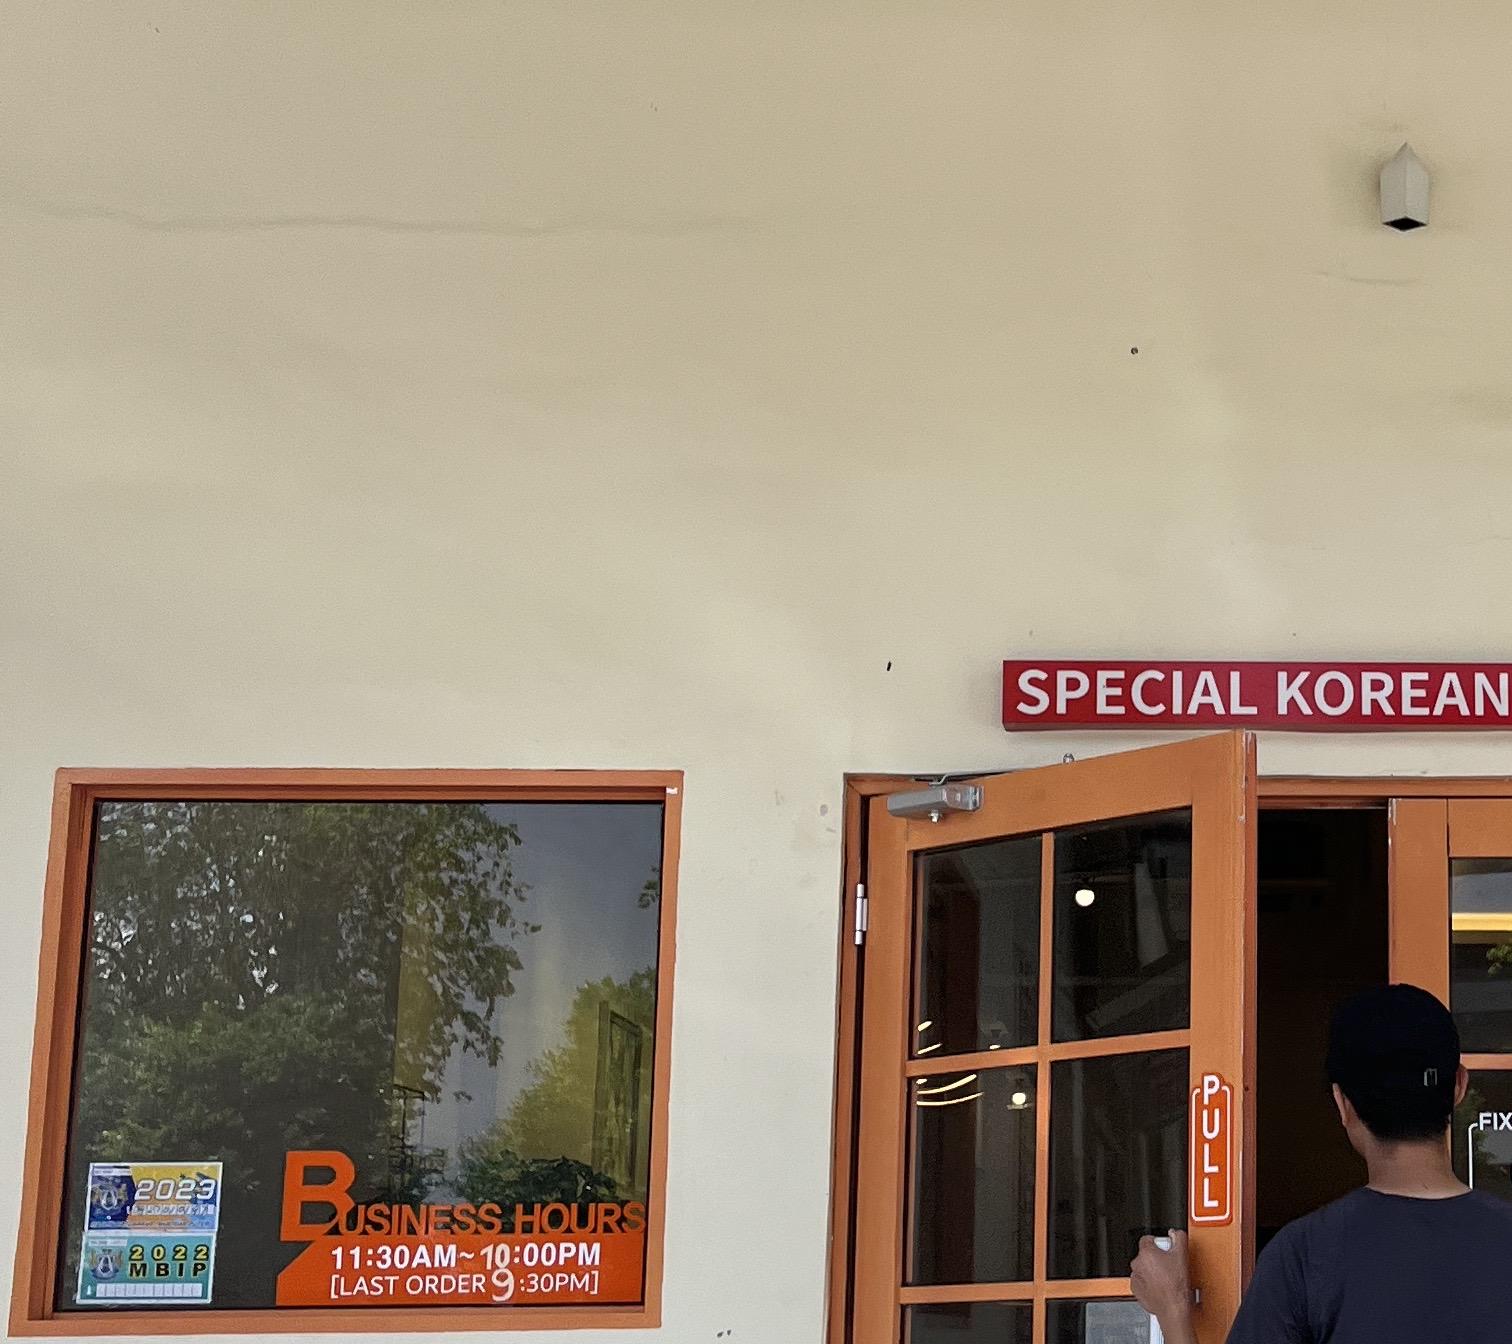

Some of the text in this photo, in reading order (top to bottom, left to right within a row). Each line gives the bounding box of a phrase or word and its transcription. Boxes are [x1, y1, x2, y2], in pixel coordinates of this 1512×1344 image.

[1016, 668, 1258, 716] SPECIAL
[1276, 669, 1510, 718] KOREAN
[1202, 1074, 1221, 1208] PULL
[134, 1179, 216, 1201] 2023
[515, 1201, 645, 1236] HOURS
[129, 1244, 210, 1262] 2022
[129, 1262, 207, 1277] MBIP
[405, 1272, 486, 1296] ORDER
